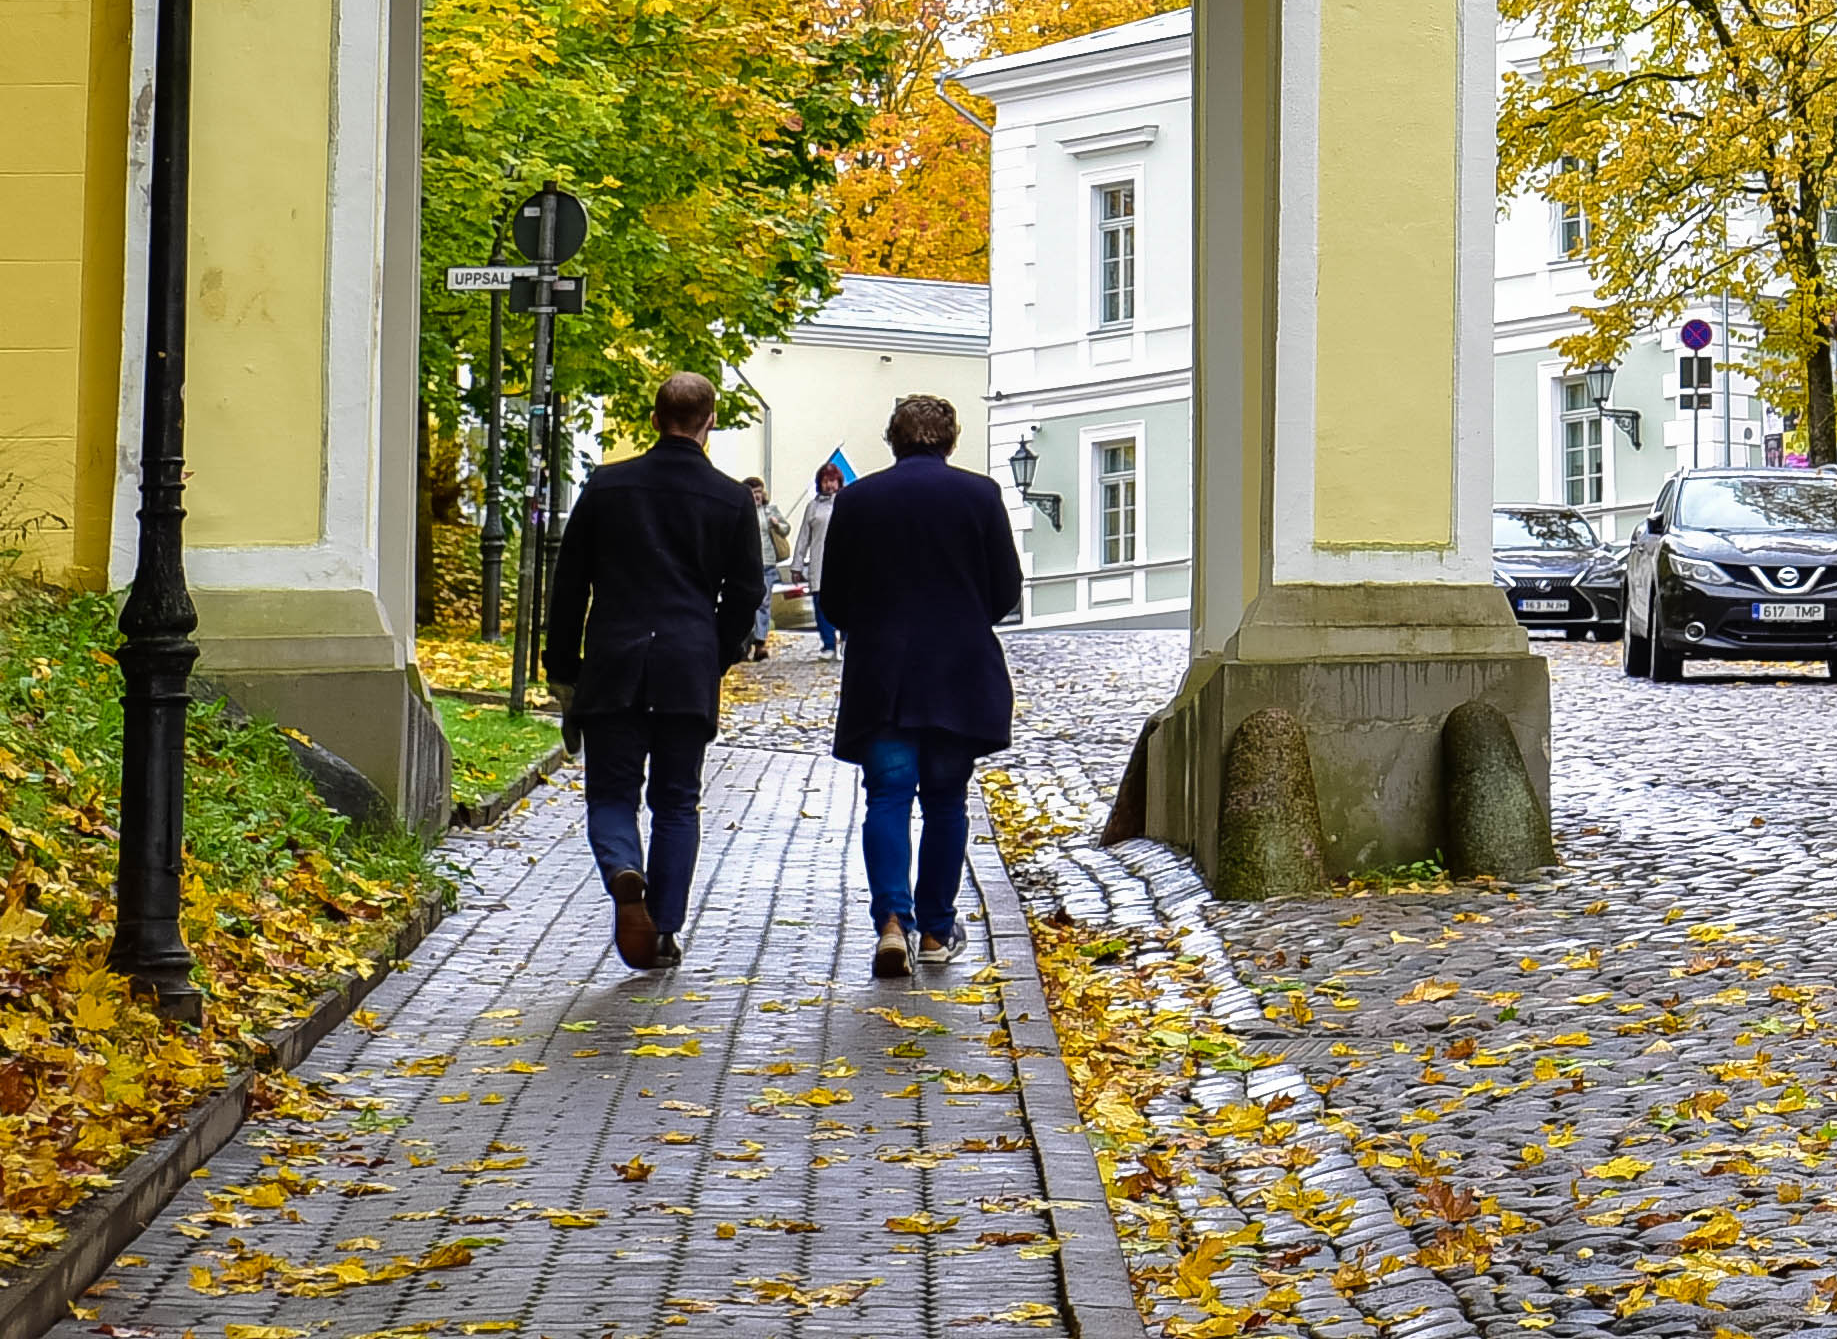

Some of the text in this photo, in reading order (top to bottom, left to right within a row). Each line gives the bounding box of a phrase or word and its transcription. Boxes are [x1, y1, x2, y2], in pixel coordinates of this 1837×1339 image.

[455, 272, 515, 285] UPPSAL
[1763, 606, 1821, 618] 617 TMP
